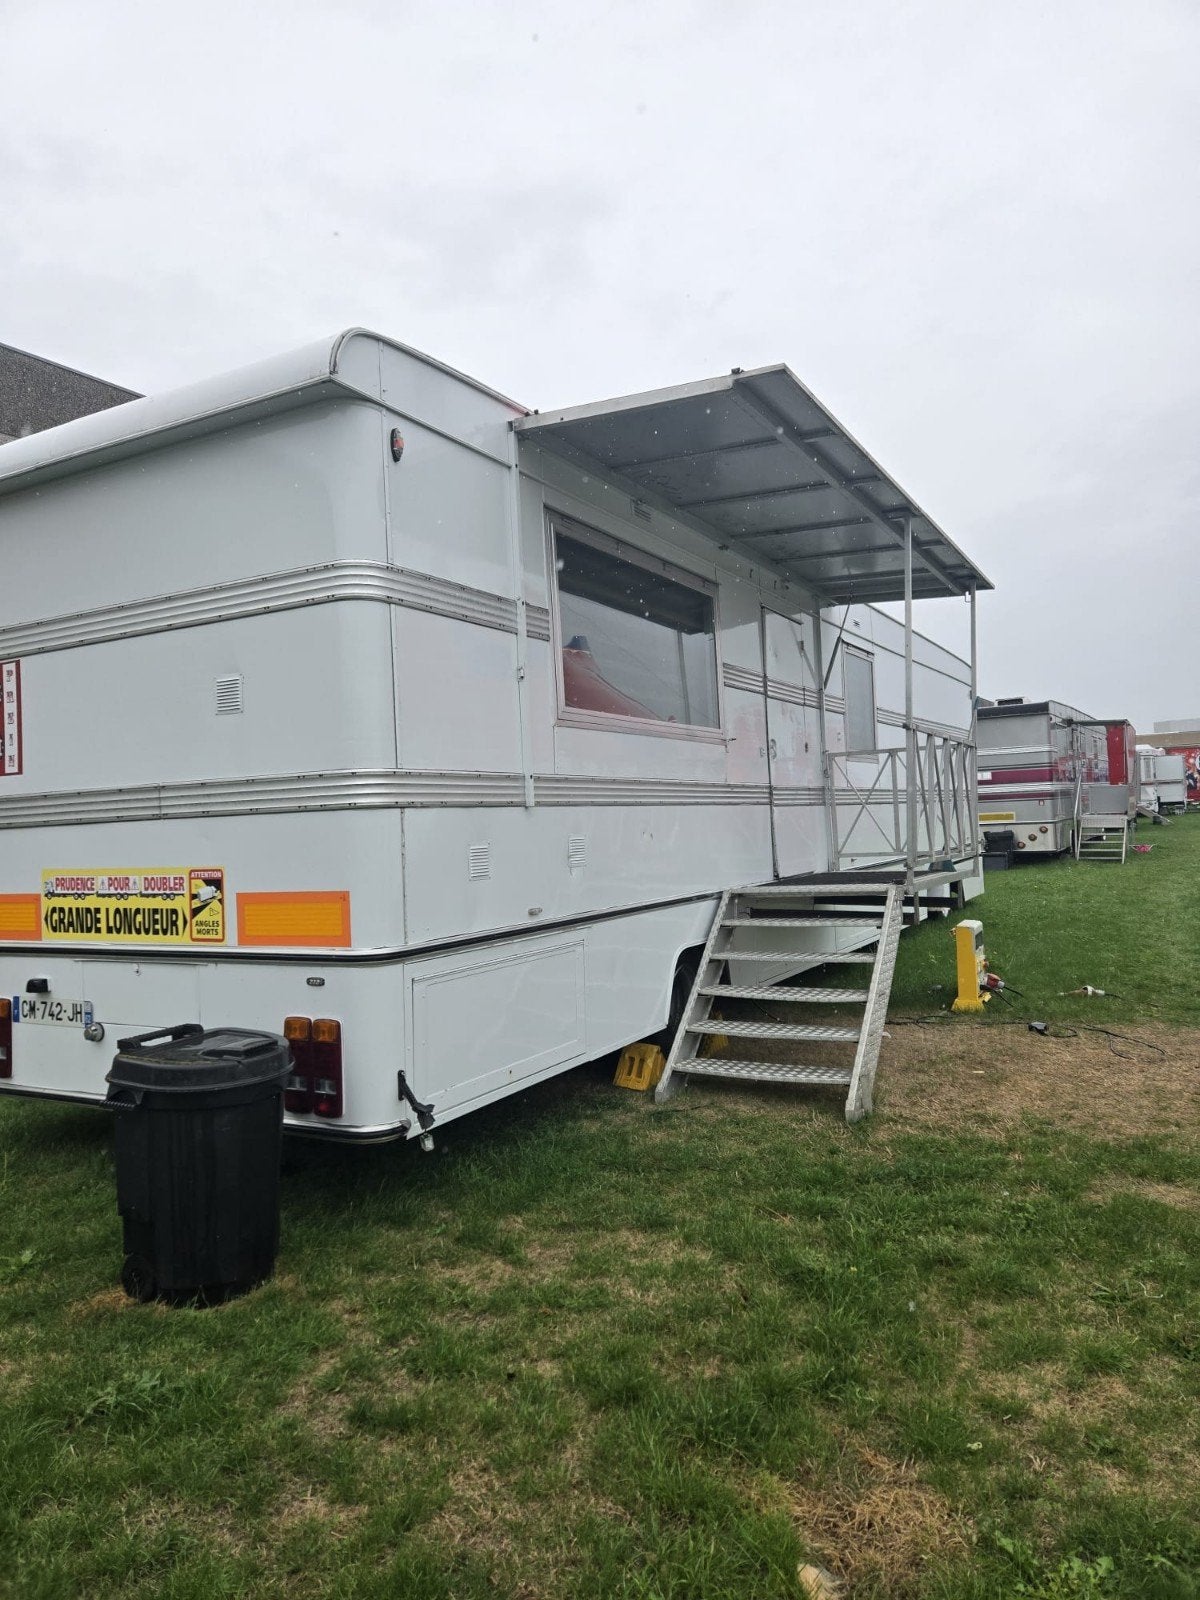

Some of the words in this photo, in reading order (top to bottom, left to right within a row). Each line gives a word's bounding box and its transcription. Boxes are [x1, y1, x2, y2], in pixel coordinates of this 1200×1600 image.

[190, 871, 222, 879] ATTENTION
[55, 877, 95, 892] PRUDENCE
[107, 877, 130, 892] POUR
[143, 876, 185, 892] DOUBLER
[50, 906, 101, 934] GRANDE
[105, 907, 179, 936] LONGUEUR
[194, 920, 220, 928] ANGLES
[196, 928, 219, 936] MORTS
